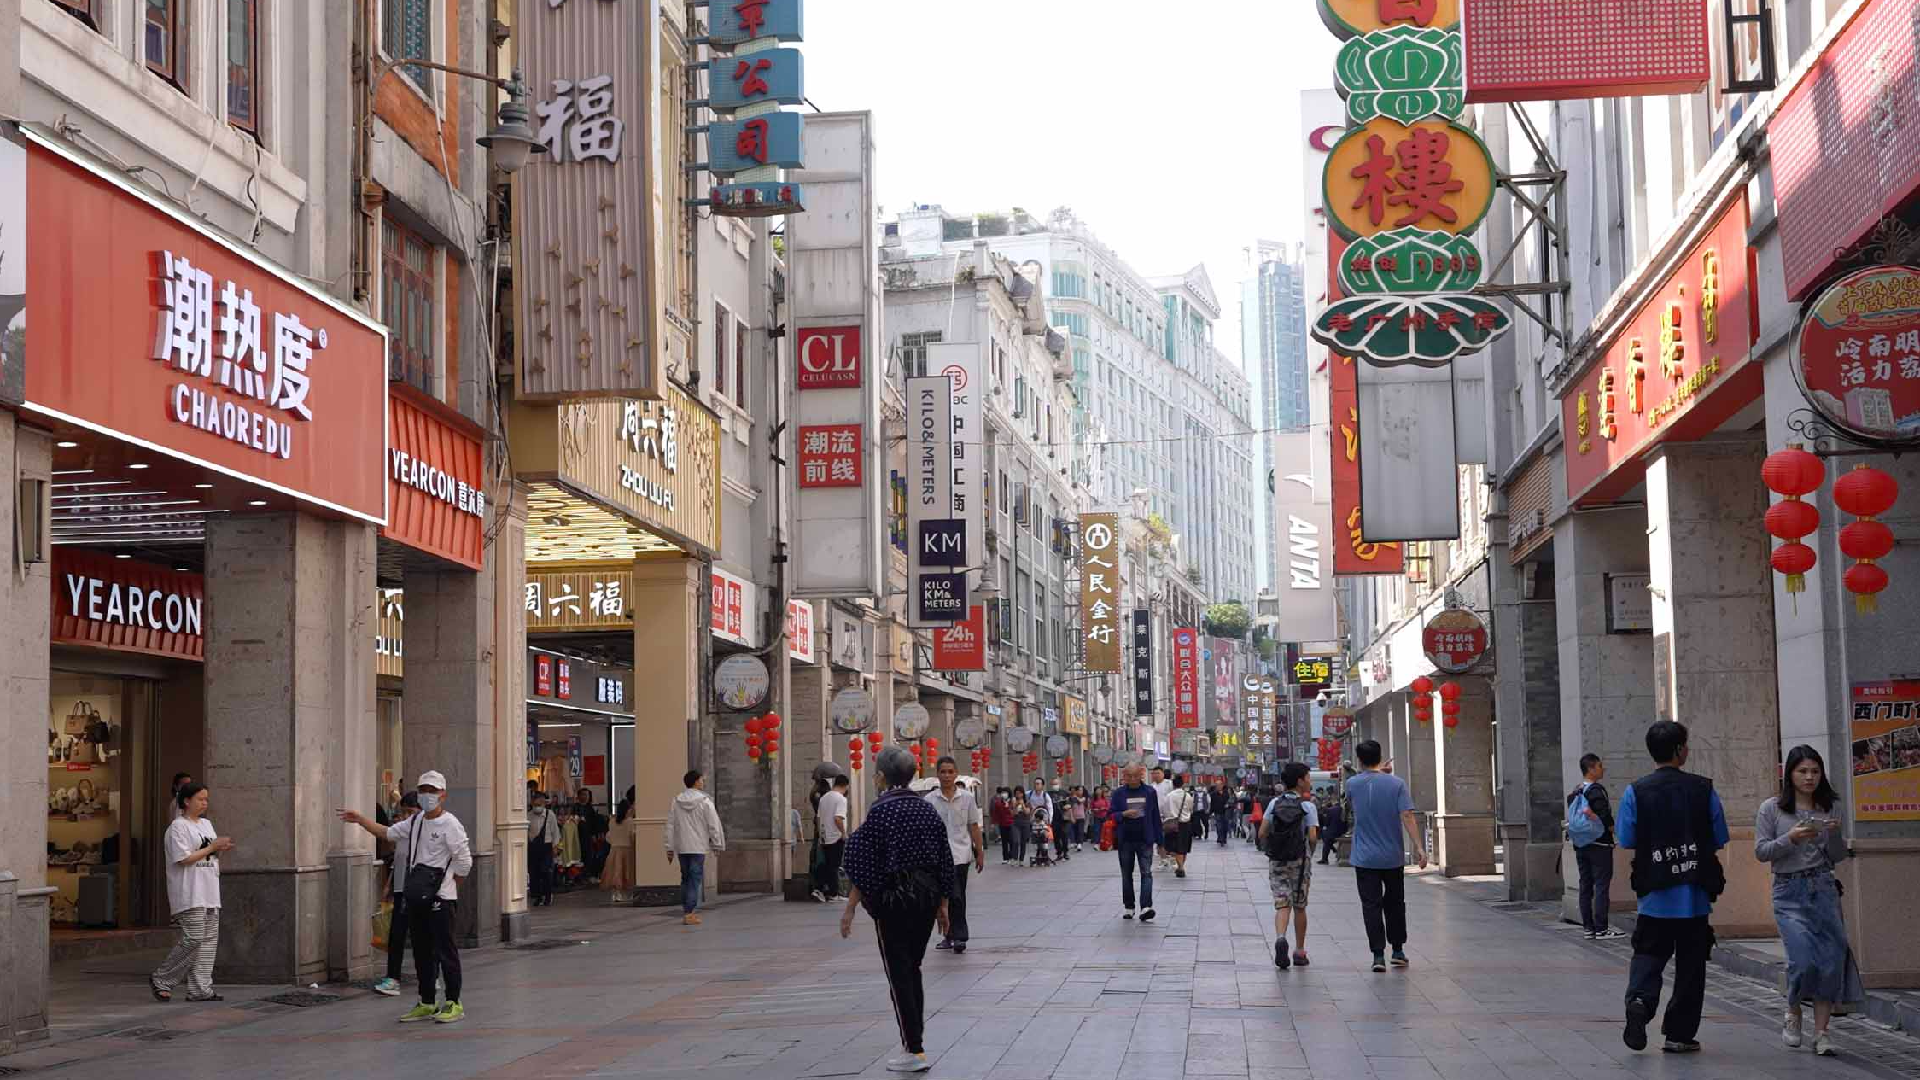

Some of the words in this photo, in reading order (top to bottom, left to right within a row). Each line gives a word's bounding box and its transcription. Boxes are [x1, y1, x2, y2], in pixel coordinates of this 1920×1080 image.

[156, 250, 312, 421] 潮热度
[802, 335, 855, 372] CL
[176, 383, 291, 458] CHAOREDU
[804, 430, 855, 453] 潮流
[393, 448, 456, 505] YEARCON
[804, 458, 855, 482] 前线
[924, 533, 960, 552] KM
[1289, 514, 1321, 589] ANTA
[924, 581, 951, 589] KILO
[924, 599, 961, 608] METERS
[67, 574, 201, 635] YEARCON
